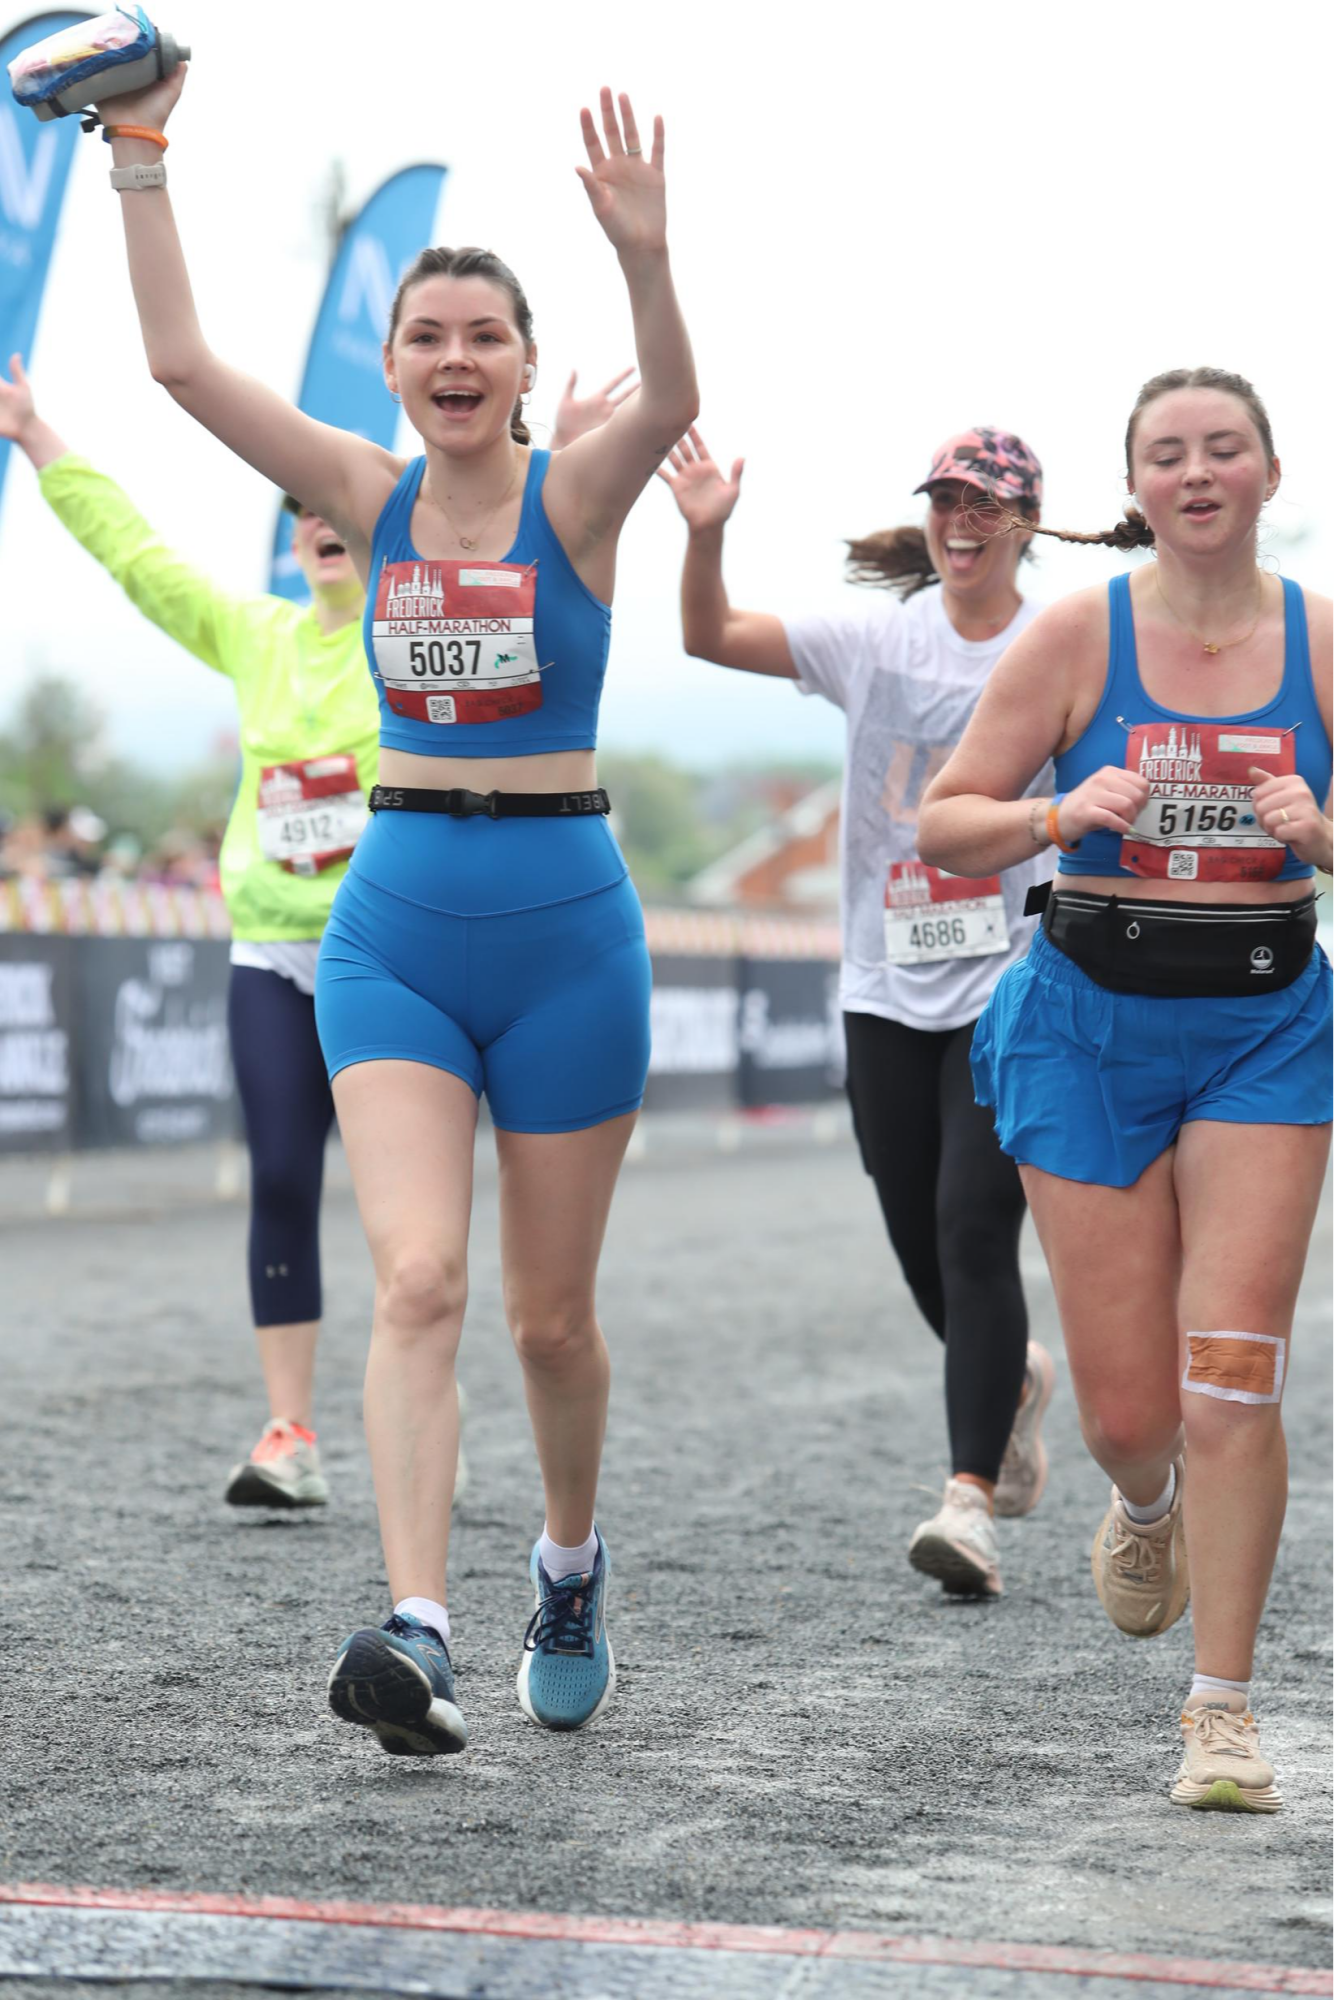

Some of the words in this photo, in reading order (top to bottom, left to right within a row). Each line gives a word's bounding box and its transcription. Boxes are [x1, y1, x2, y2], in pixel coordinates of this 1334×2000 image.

[387, 597, 444, 618] FREDERICK
[388, 619, 511, 634] HALF-MARATHON
[410, 641, 481, 676] 5037
[1139, 759, 1201, 781] FREDERICK
[1151, 784, 1255, 799] ALF-MARATH
[280, 814, 332, 843] 4912
[1159, 804, 1237, 835] 5156
[910, 918, 966, 949] 4686
